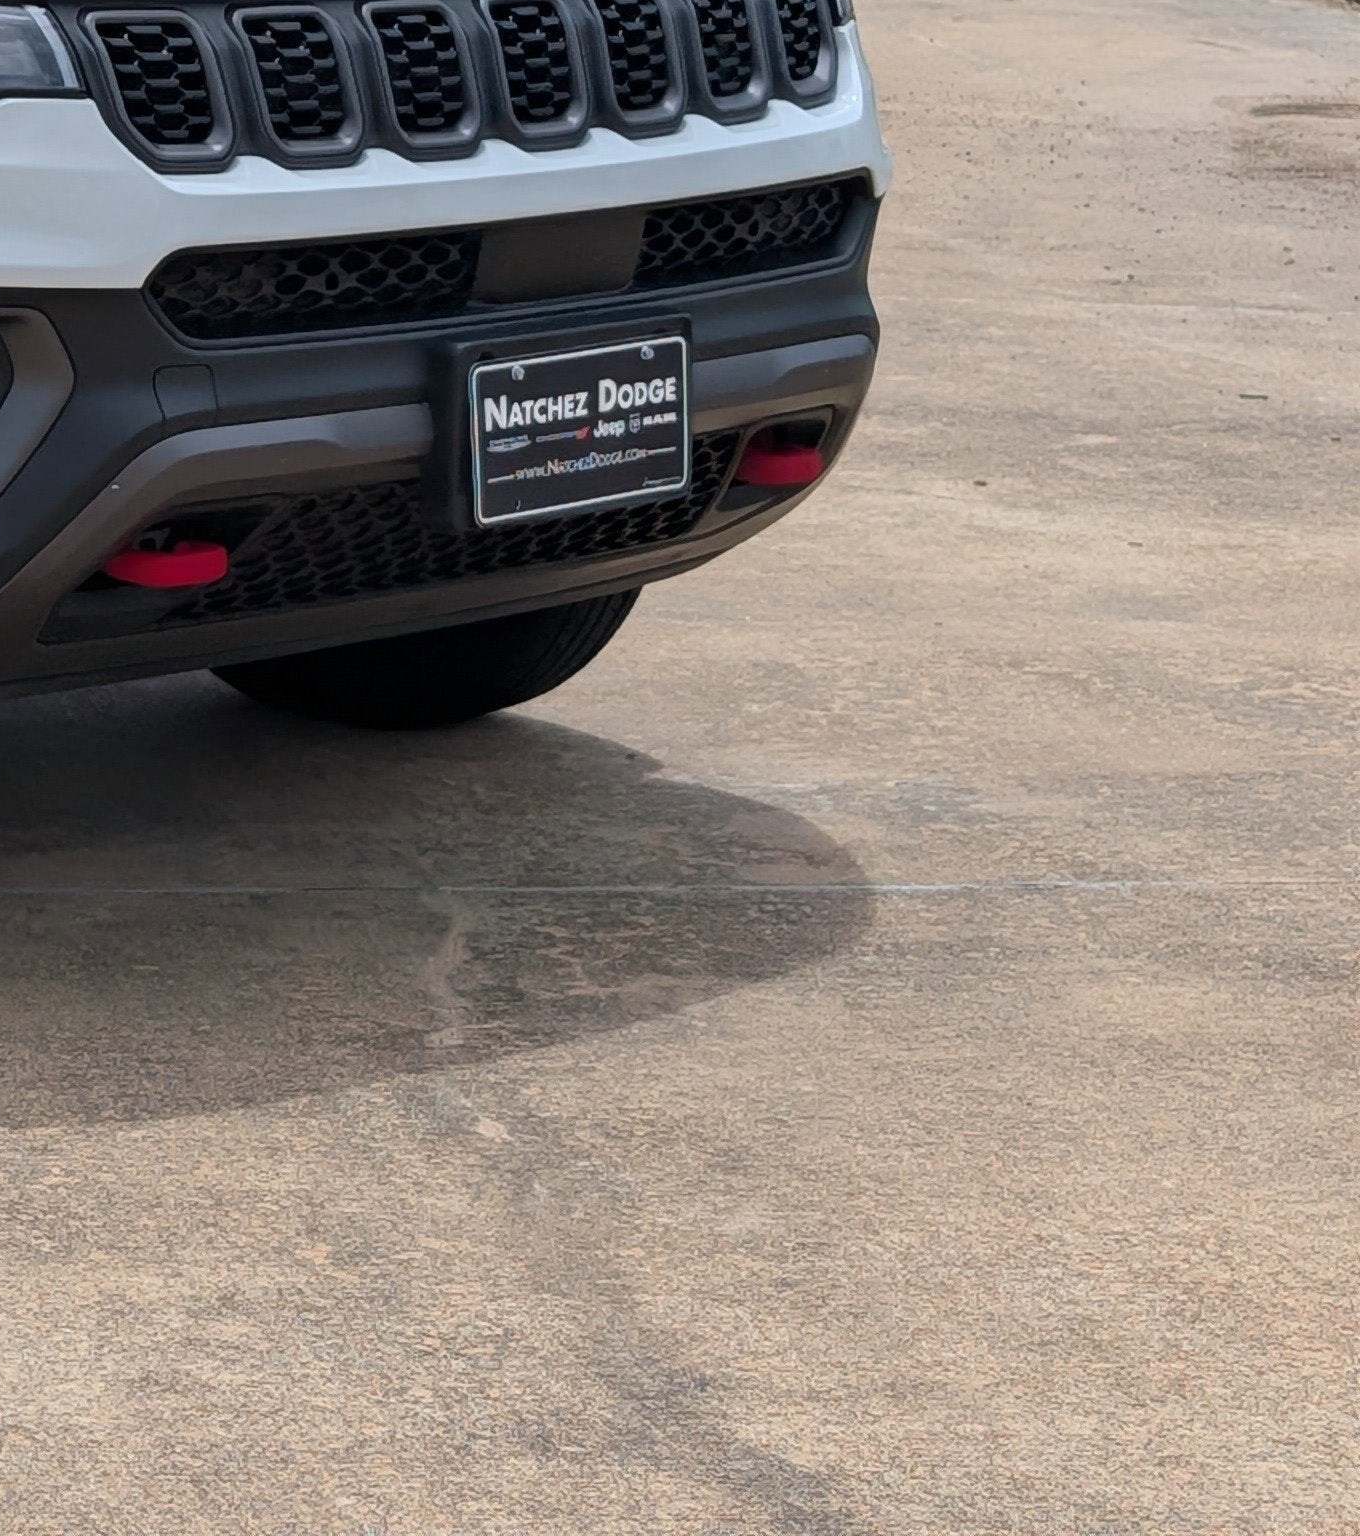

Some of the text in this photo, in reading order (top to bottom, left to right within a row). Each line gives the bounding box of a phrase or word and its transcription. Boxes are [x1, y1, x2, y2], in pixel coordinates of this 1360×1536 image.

[483, 376, 677, 433] NATCHEZ DODGE
[593, 419, 626, 438] Jeep
